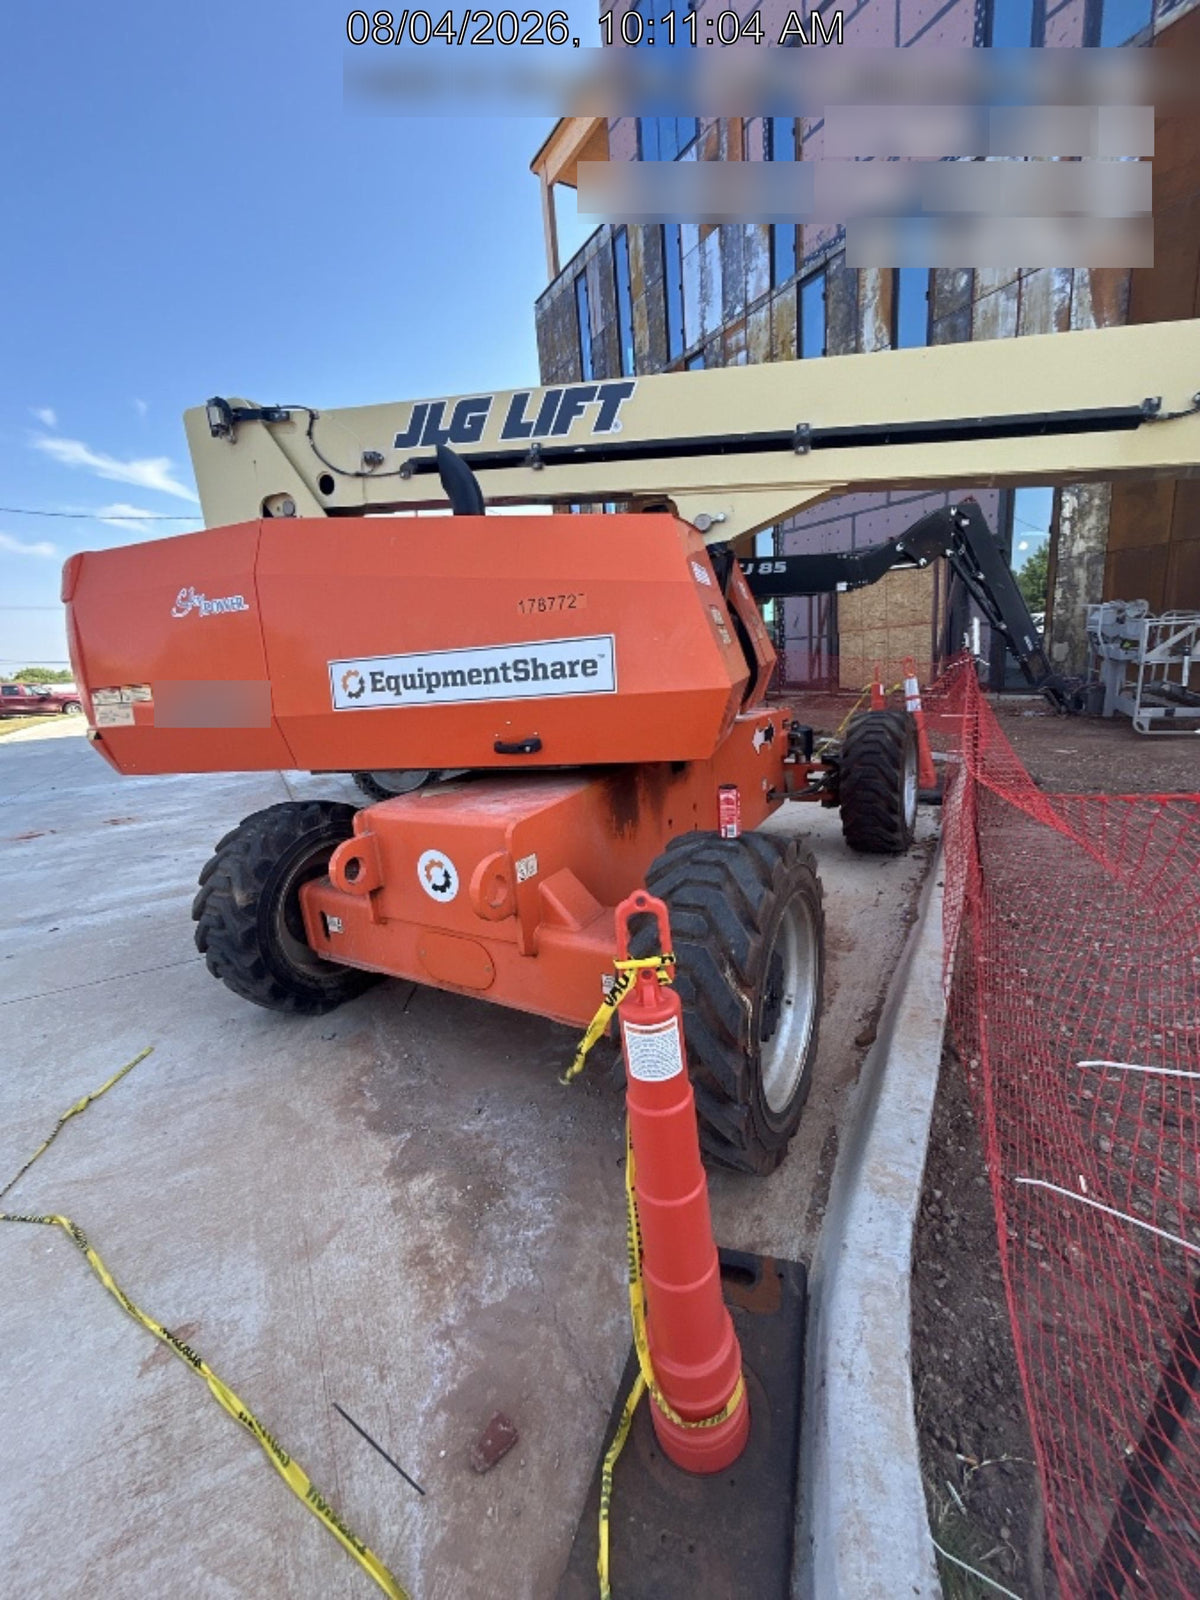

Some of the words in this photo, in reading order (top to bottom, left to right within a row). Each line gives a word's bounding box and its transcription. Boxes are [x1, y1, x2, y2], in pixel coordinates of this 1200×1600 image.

[393, 395, 495, 450] JLG
[499, 380, 638, 442] LIFT
[758, 561, 787, 575] 85
[518, 592, 585, 614] 178772
[369, 656, 599, 697] EquipmentShare
